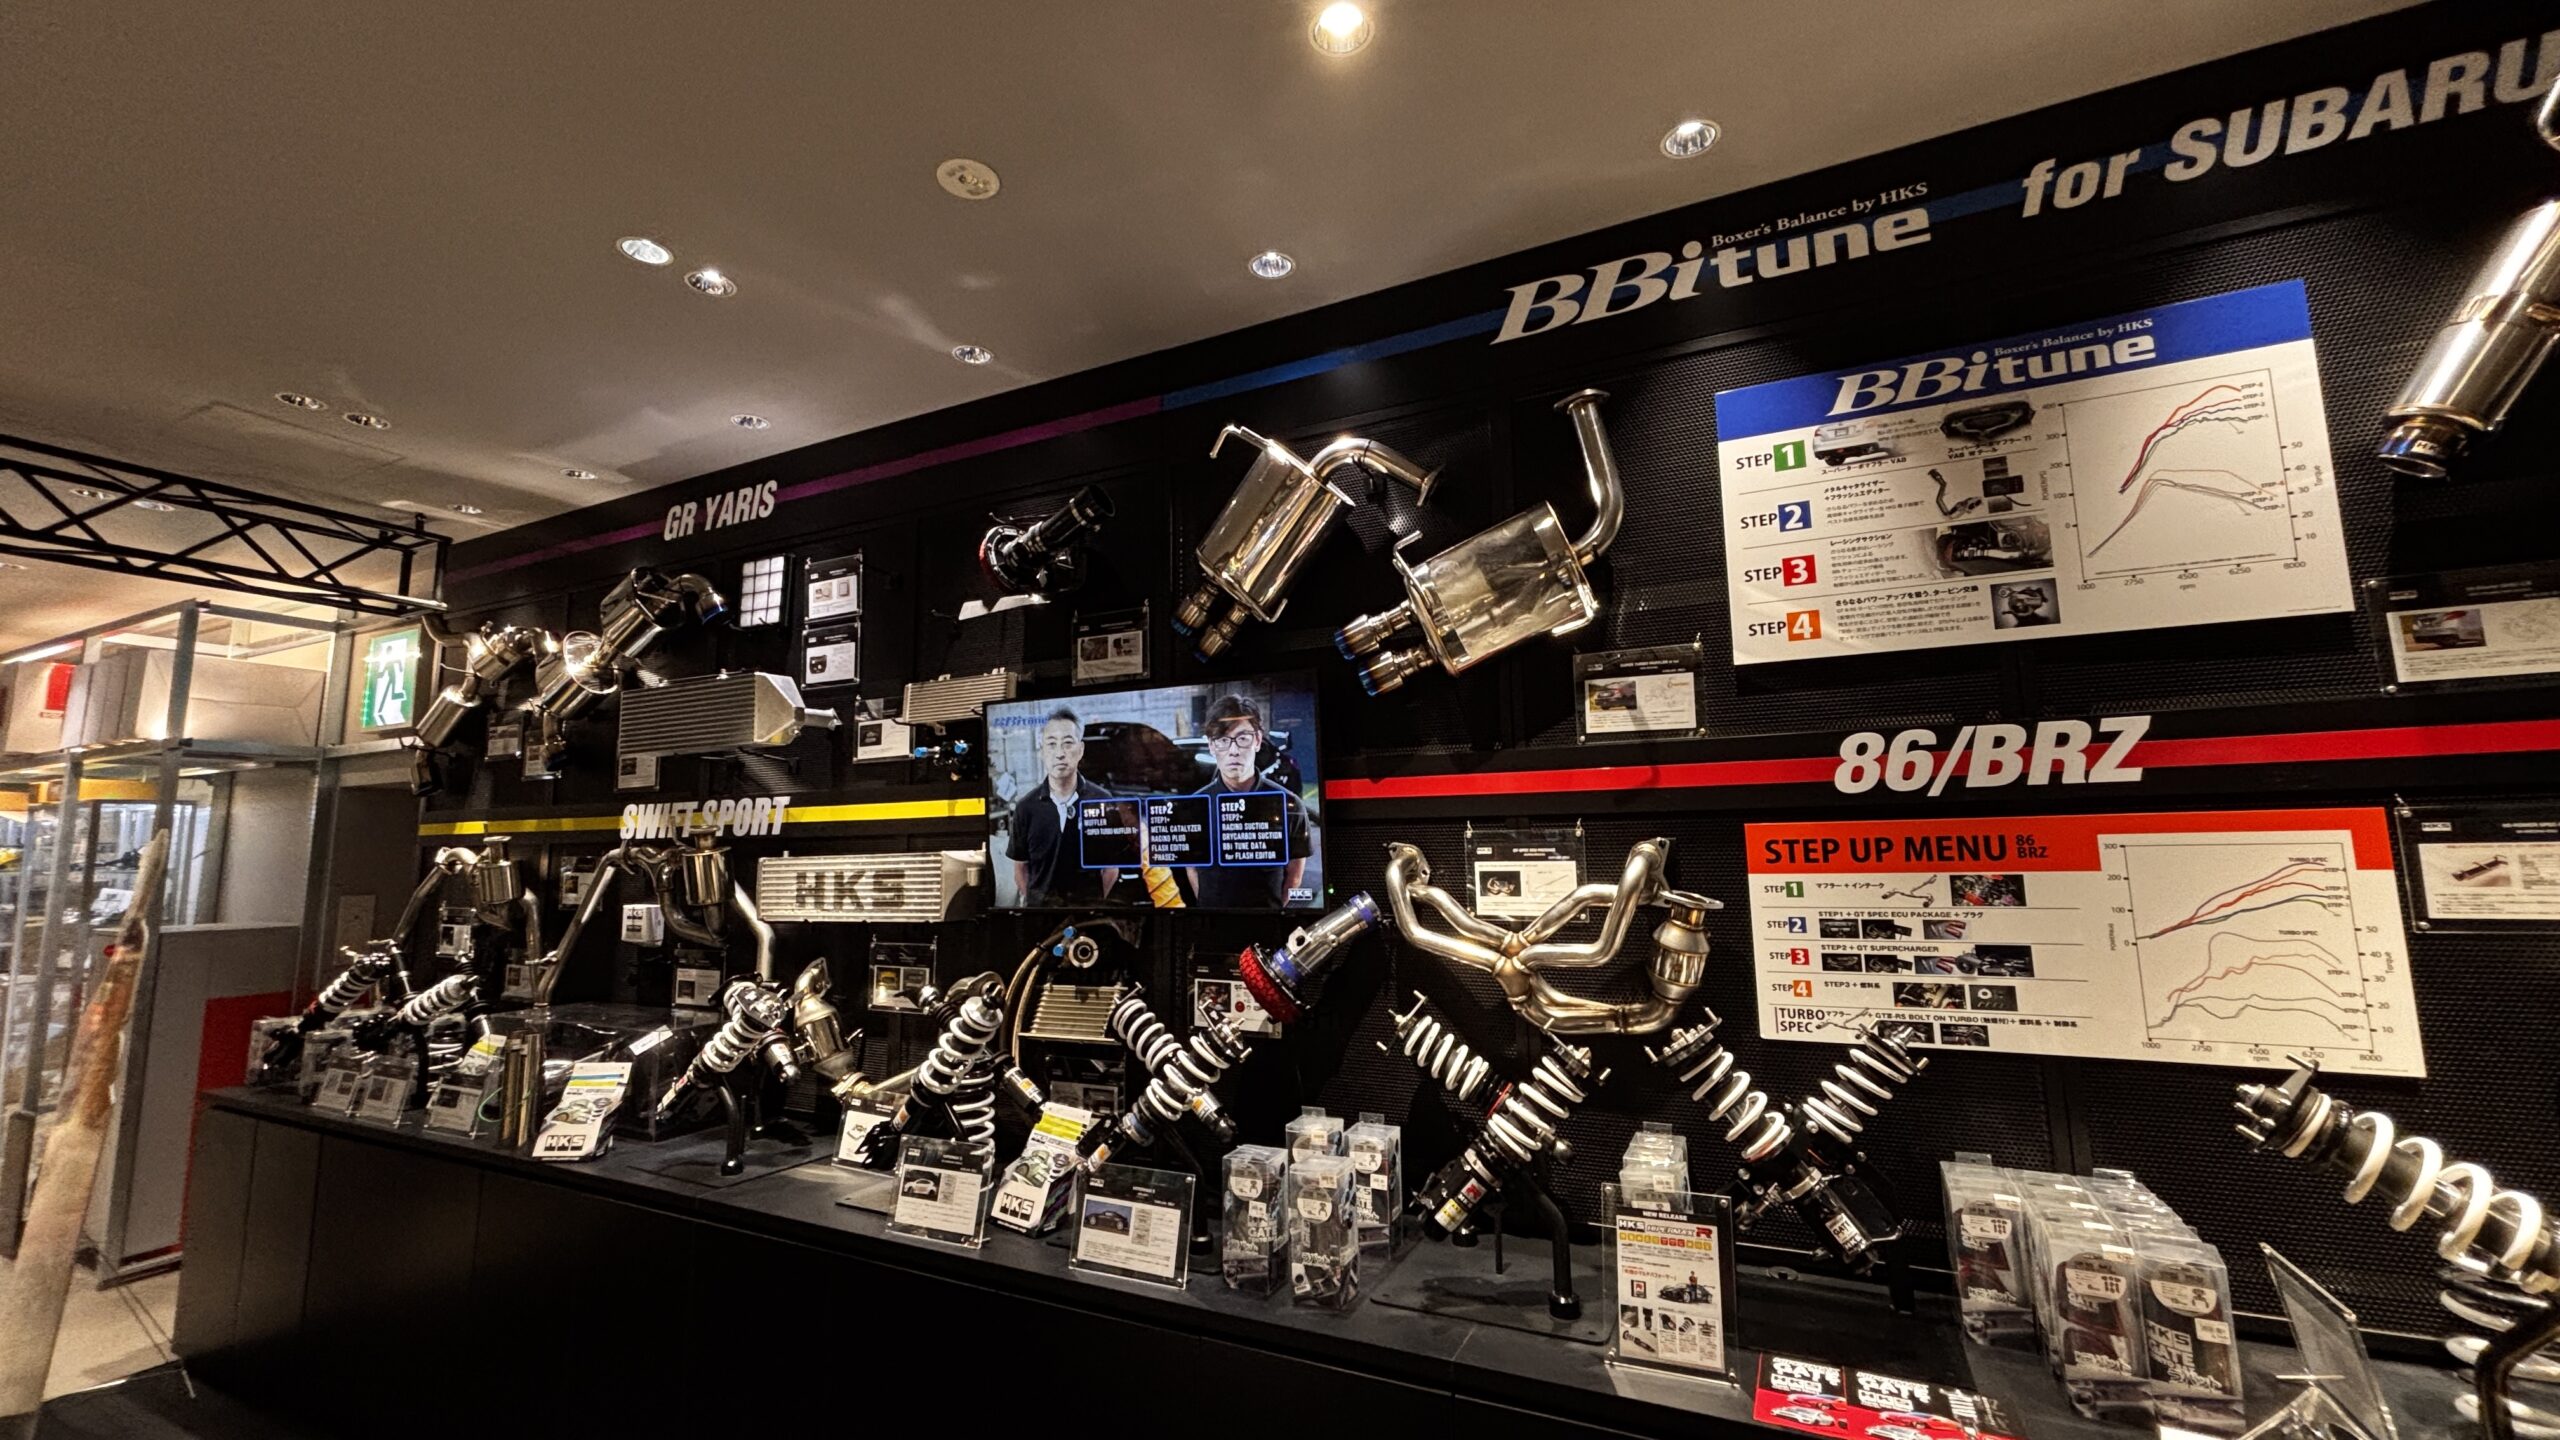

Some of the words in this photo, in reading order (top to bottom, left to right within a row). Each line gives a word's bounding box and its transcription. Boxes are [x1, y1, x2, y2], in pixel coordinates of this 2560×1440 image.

[2021, 147, 2145, 218] for
[2163, 30, 2560, 182] SUBARU
[1710, 223, 1772, 248] Boxer's
[1776, 204, 1847, 232] Balance
[1850, 198, 1876, 214] by
[1879, 182, 1928, 205] HKS
[1994, 340, 2039, 358] Boxer's
[2043, 329, 2094, 353] Balance
[2097, 326, 2114, 341] by
[2118, 316, 2154, 333] HKS
[2290, 441, 2303, 449] 50
[1736, 453, 1772, 470] STEP
[2294, 464, 2306, 472] 40
[2297, 485, 2309, 494] 30
[664, 501, 697, 541] GR
[704, 480, 778, 531] YARIS
[2301, 511, 2313, 519] 20
[1740, 512, 1777, 529] STEP
[2305, 532, 2317, 540] 10
[1744, 566, 1782, 582] STEP
[2076, 583, 2095, 591] 1000
[2124, 577, 2144, 586] 2750
[2177, 572, 2198, 580] 4500
[2229, 567, 2251, 575] 6250
[2283, 560, 2306, 569] 8000
[1748, 620, 1786, 636] STEP
[1833, 715, 2151, 797] 86/BRZ
[1150, 802, 1173, 815] STEP2
[1221, 799, 1246, 812] STEP3
[620, 801, 698, 838] SWIFT
[702, 796, 790, 837] SPORT
[1150, 825, 1169, 833] METAL
[1170, 824, 1202, 832] CATALYZER
[1258, 831, 1282, 840] SUCTION
[2016, 834, 2036, 846] 86
[1151, 844, 1169, 852] FLASH
[1250, 842, 1267, 850] DATA
[1764, 837, 1840, 864] STEP
[1849, 836, 1894, 863] UP
[1904, 833, 2008, 863] MENU
[1235, 851, 1254, 859] FLASH
[1255, 851, 1276, 859] EDITOR
[2017, 846, 2049, 859] BRZ
[794, 870, 905, 909] HKS
[1764, 884, 1785, 894] STEP
[1815, 882, 1841, 890] マフラー
[1288, 888, 1313, 900] HKS
[2112, 906, 2125, 914] 100
[1767, 920, 1788, 930] STEP
[1870, 945, 1939, 953] SUPERCHARGER
[1769, 951, 1791, 961] STEP
[2373, 975, 2386, 983] 30
[1772, 983, 1793, 993] STEP
[2378, 1002, 2390, 1010] 20
[1779, 1007, 1826, 1021] TURBO
[1908, 1013, 1931, 1021] BOLT
[1948, 1015, 1978, 1023] TURBO
[1780, 1020, 1813, 1033] SPEC
[2381, 1026, 2394, 1034] 10
[2141, 1042, 2161, 1050] 1000
[2359, 1053, 2382, 1062] 8000
[544, 1135, 587, 1152] HKS
[1000, 1192, 1035, 1222] HKS
[1642, 1210, 1657, 1218] NEW
[1658, 1212, 1688, 1221] RELEASE
[1618, 1219, 1645, 1233] HKS
